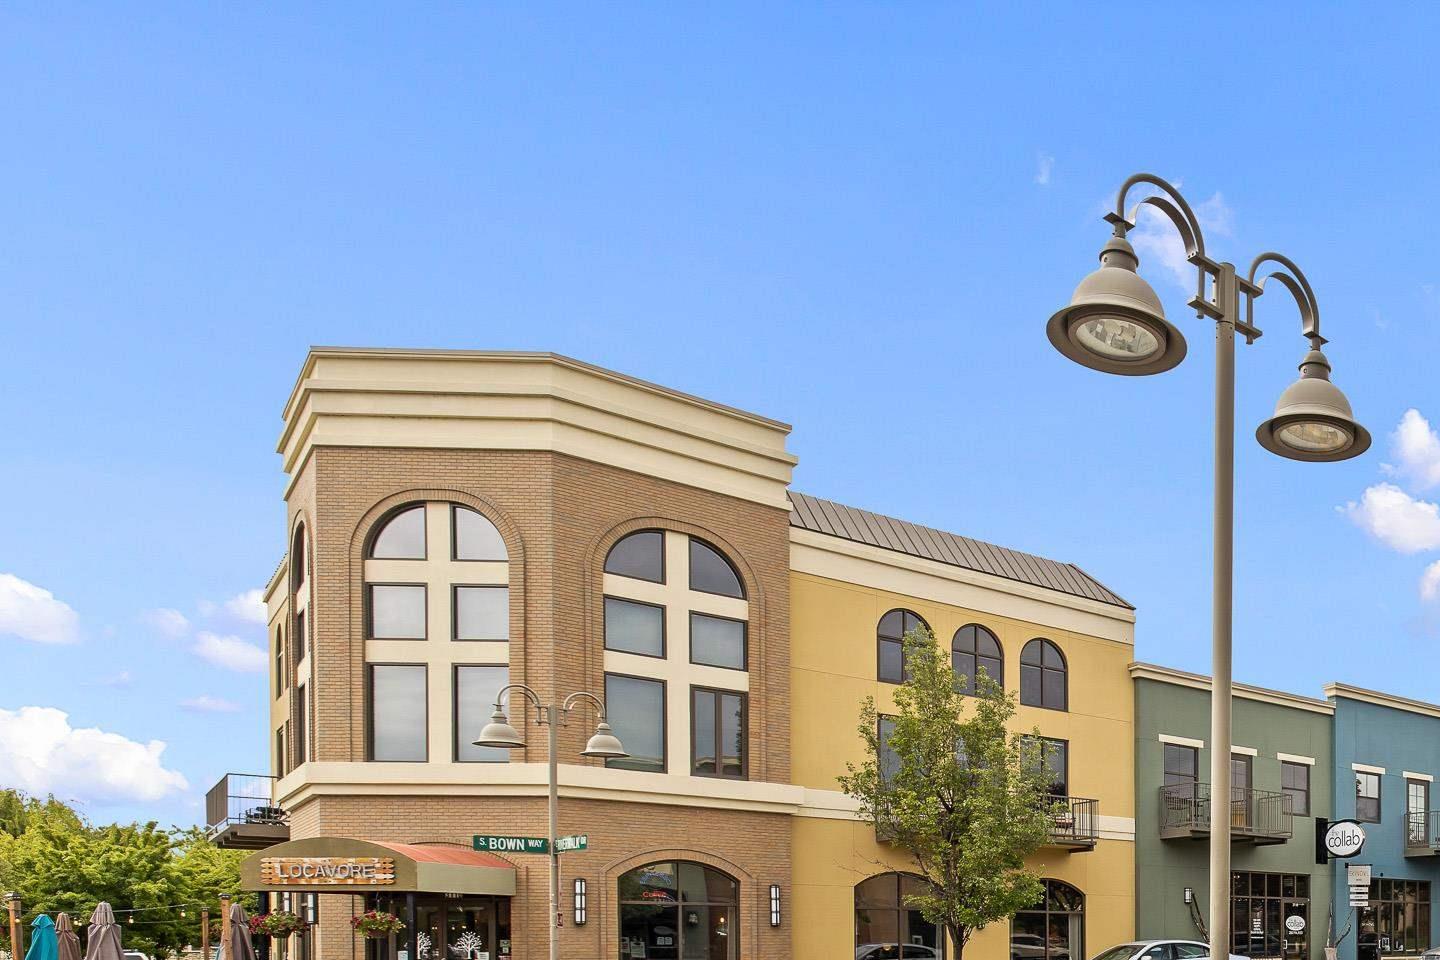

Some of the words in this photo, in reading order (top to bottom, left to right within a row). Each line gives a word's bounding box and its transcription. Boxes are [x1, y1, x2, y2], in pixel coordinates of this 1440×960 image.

[479, 837, 487, 846] S.
[488, 837, 525, 851] BOWN
[527, 838, 544, 848] WAY
[1328, 829, 1361, 848] collab
[277, 863, 376, 879] LOCAVORE
